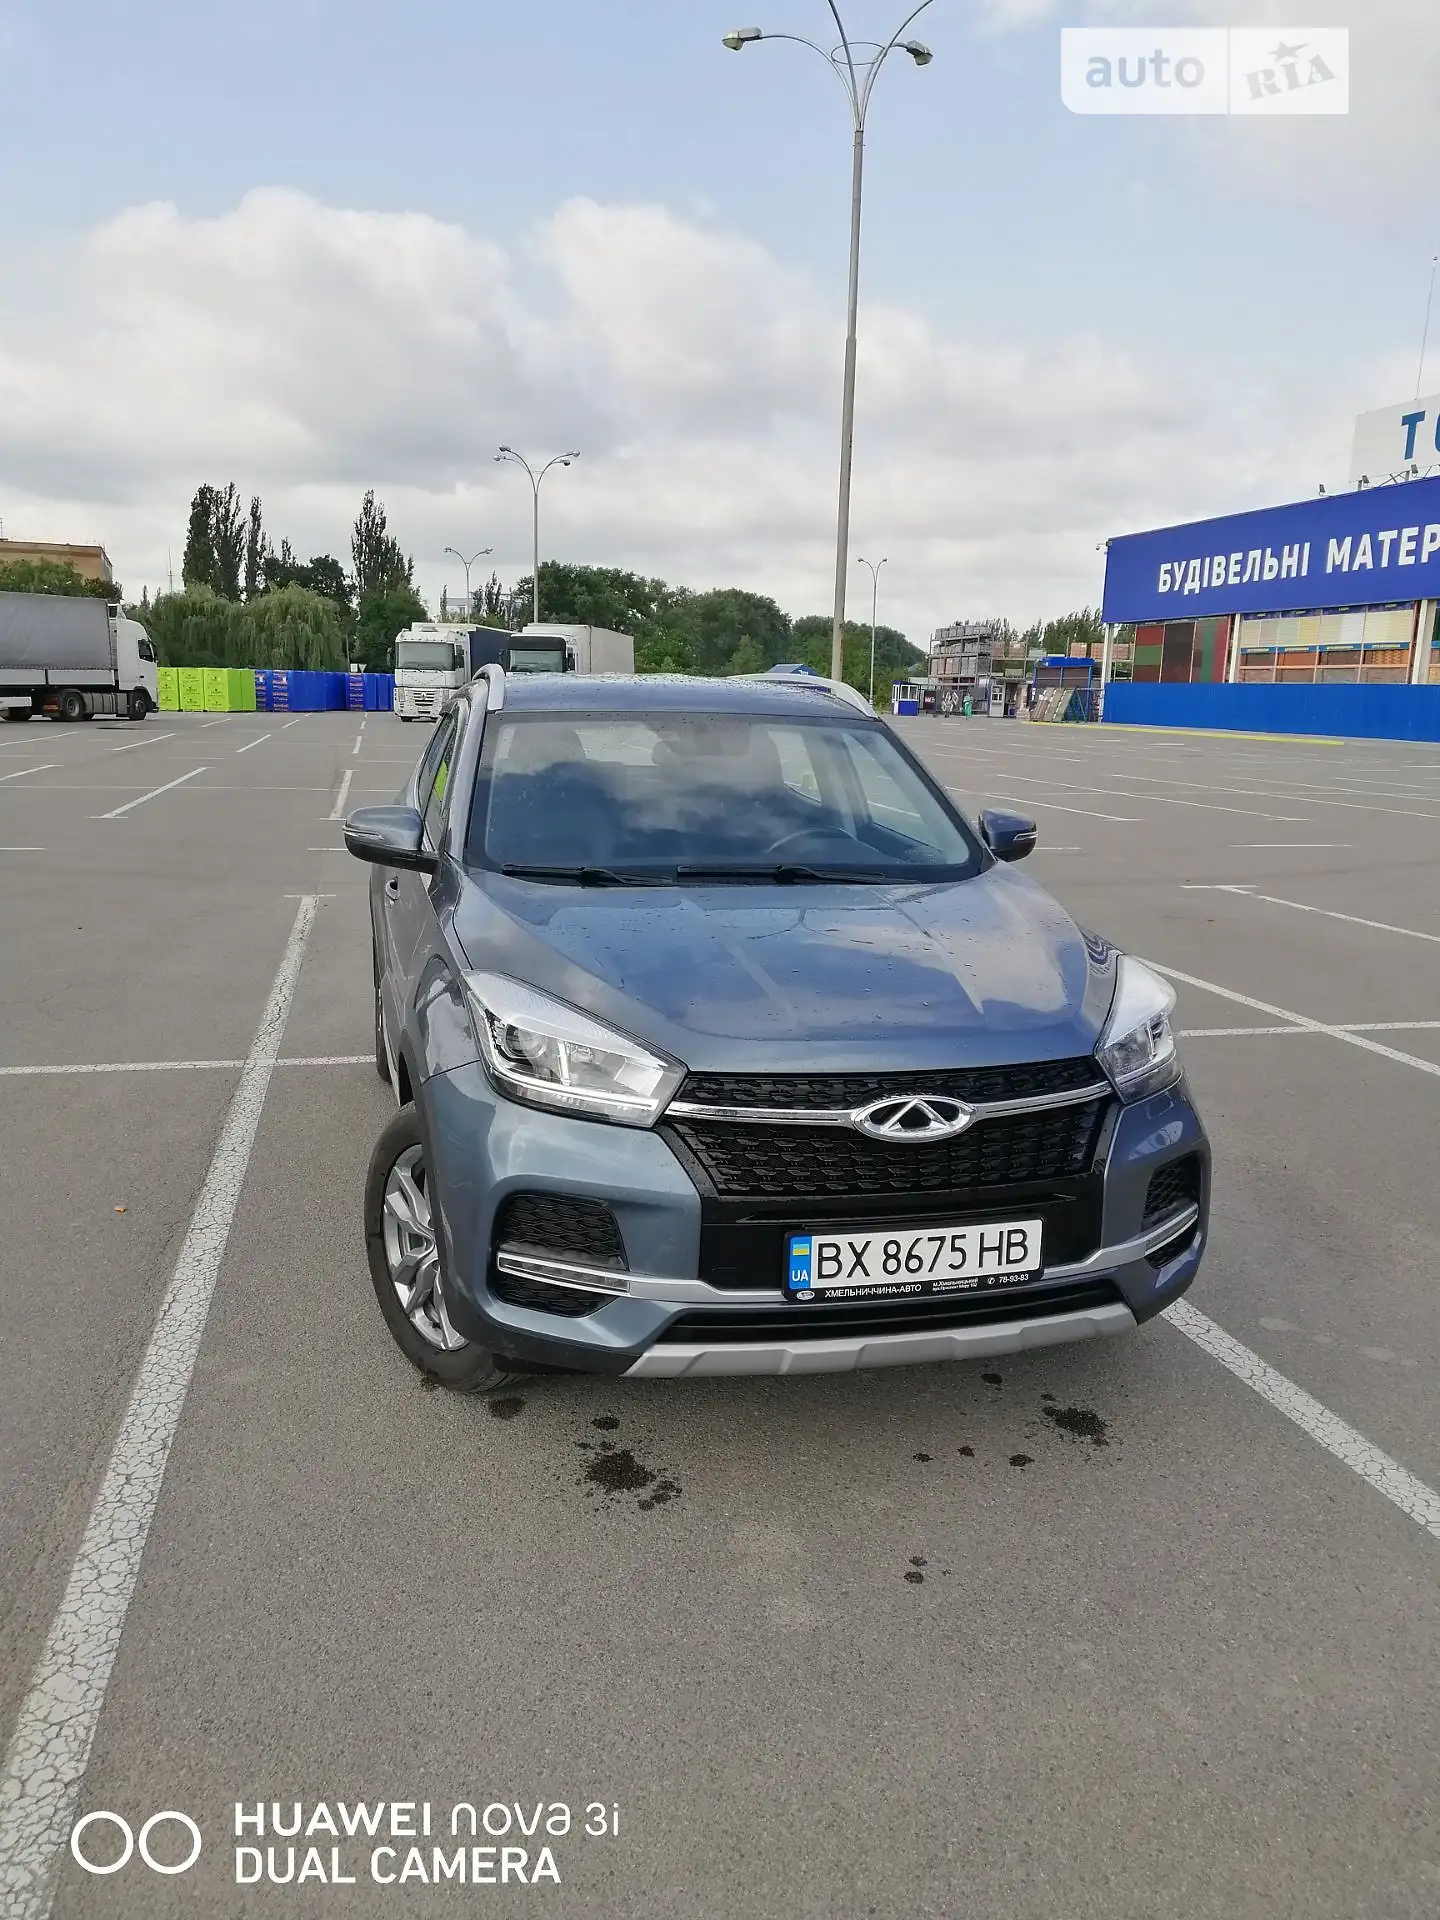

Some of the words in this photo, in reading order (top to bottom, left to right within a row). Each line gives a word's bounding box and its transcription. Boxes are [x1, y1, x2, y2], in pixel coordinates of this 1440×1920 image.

[1158, 542, 1311, 595] БУДІВЕЛЬНІ
[1326, 523, 1440, 574] МАТЕР
[817, 1241, 872, 1279] BX
[882, 1233, 967, 1275] 8675
[979, 1229, 1028, 1268] HB
[792, 1269, 809, 1281] UA
[825, 1284, 922, 1298] ХМЕЛЬНИЧЧИНА-АВТО
